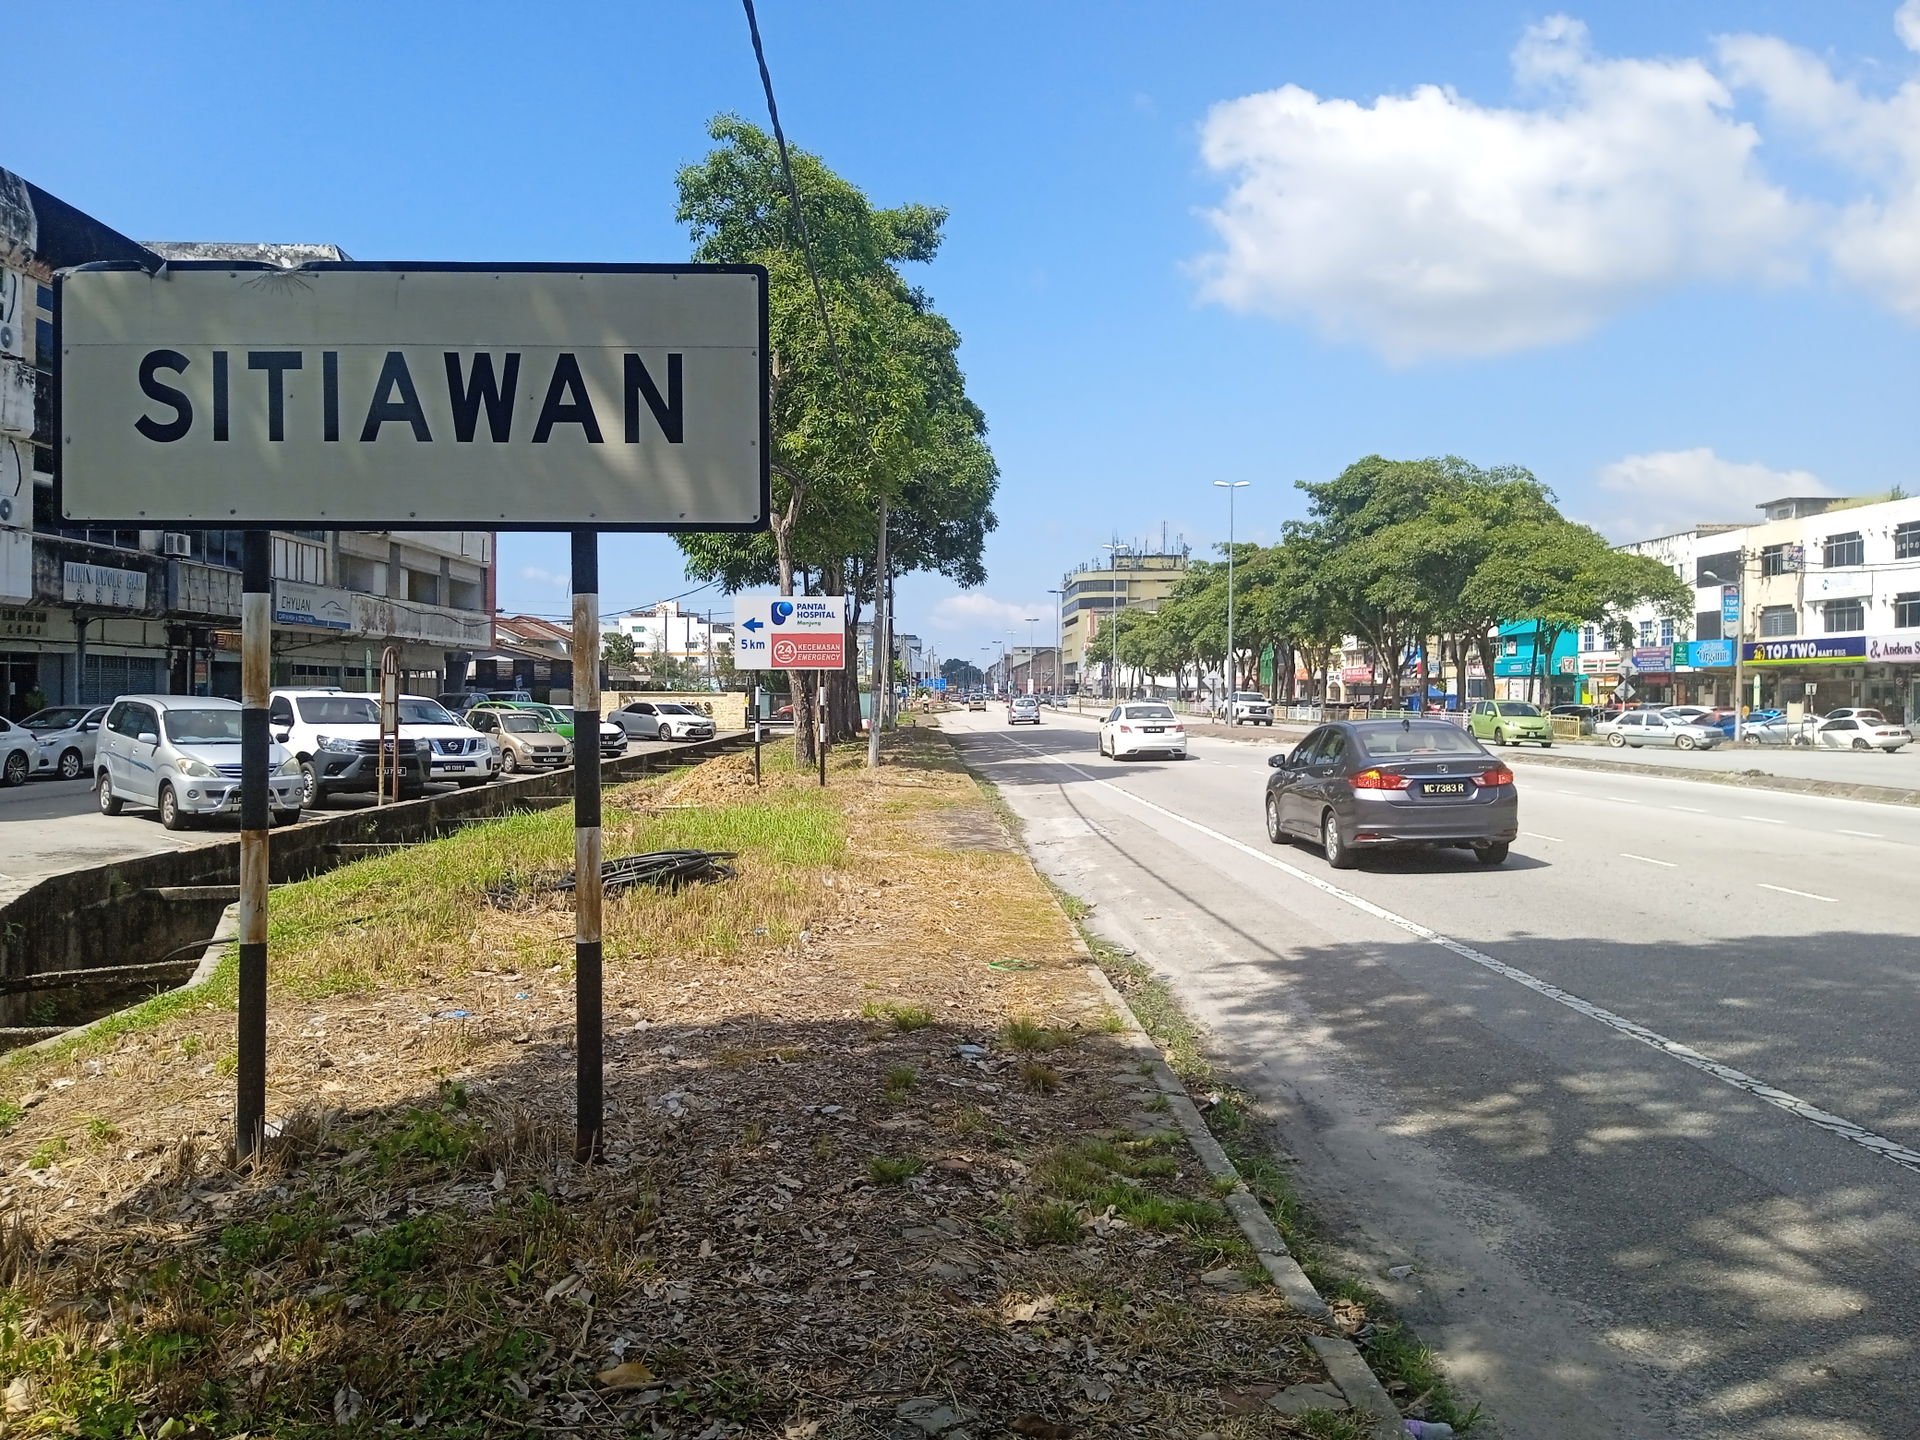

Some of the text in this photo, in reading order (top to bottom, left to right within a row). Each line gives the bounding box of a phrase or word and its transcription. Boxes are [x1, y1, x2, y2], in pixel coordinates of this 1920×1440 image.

[134, 349, 684, 443] SITIAWAN
[796, 603, 826, 611] PANTAI
[796, 611, 836, 619] HOSPITAL
[741, 640, 765, 650] 5 km
[777, 644, 793, 655] 24
[797, 643, 840, 651] KECEMASAN
[1883, 642, 1912, 655] Andora
[1766, 644, 1788, 659] TOP
[1790, 642, 1817, 658] TWO
[1817, 649, 1833, 657] MART
[797, 653, 841, 661] EMERGENCY
[1435, 783, 1457, 793] 7383
[1458, 783, 1464, 792] R
